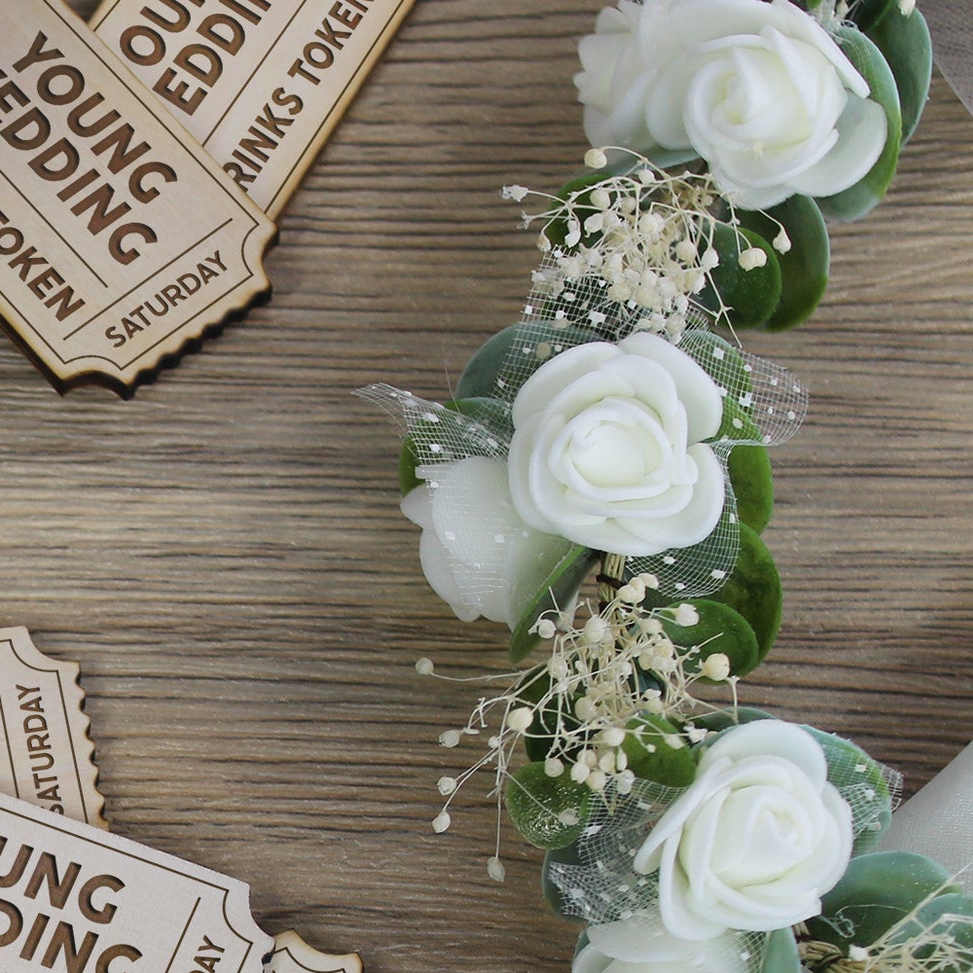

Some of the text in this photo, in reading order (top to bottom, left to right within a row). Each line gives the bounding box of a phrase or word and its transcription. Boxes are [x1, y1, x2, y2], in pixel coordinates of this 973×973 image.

[13, 32, 178, 204] YOUNG
[222, 0, 375, 193] RINKS TOKE
[105, 250, 229, 348] SATURDAY
